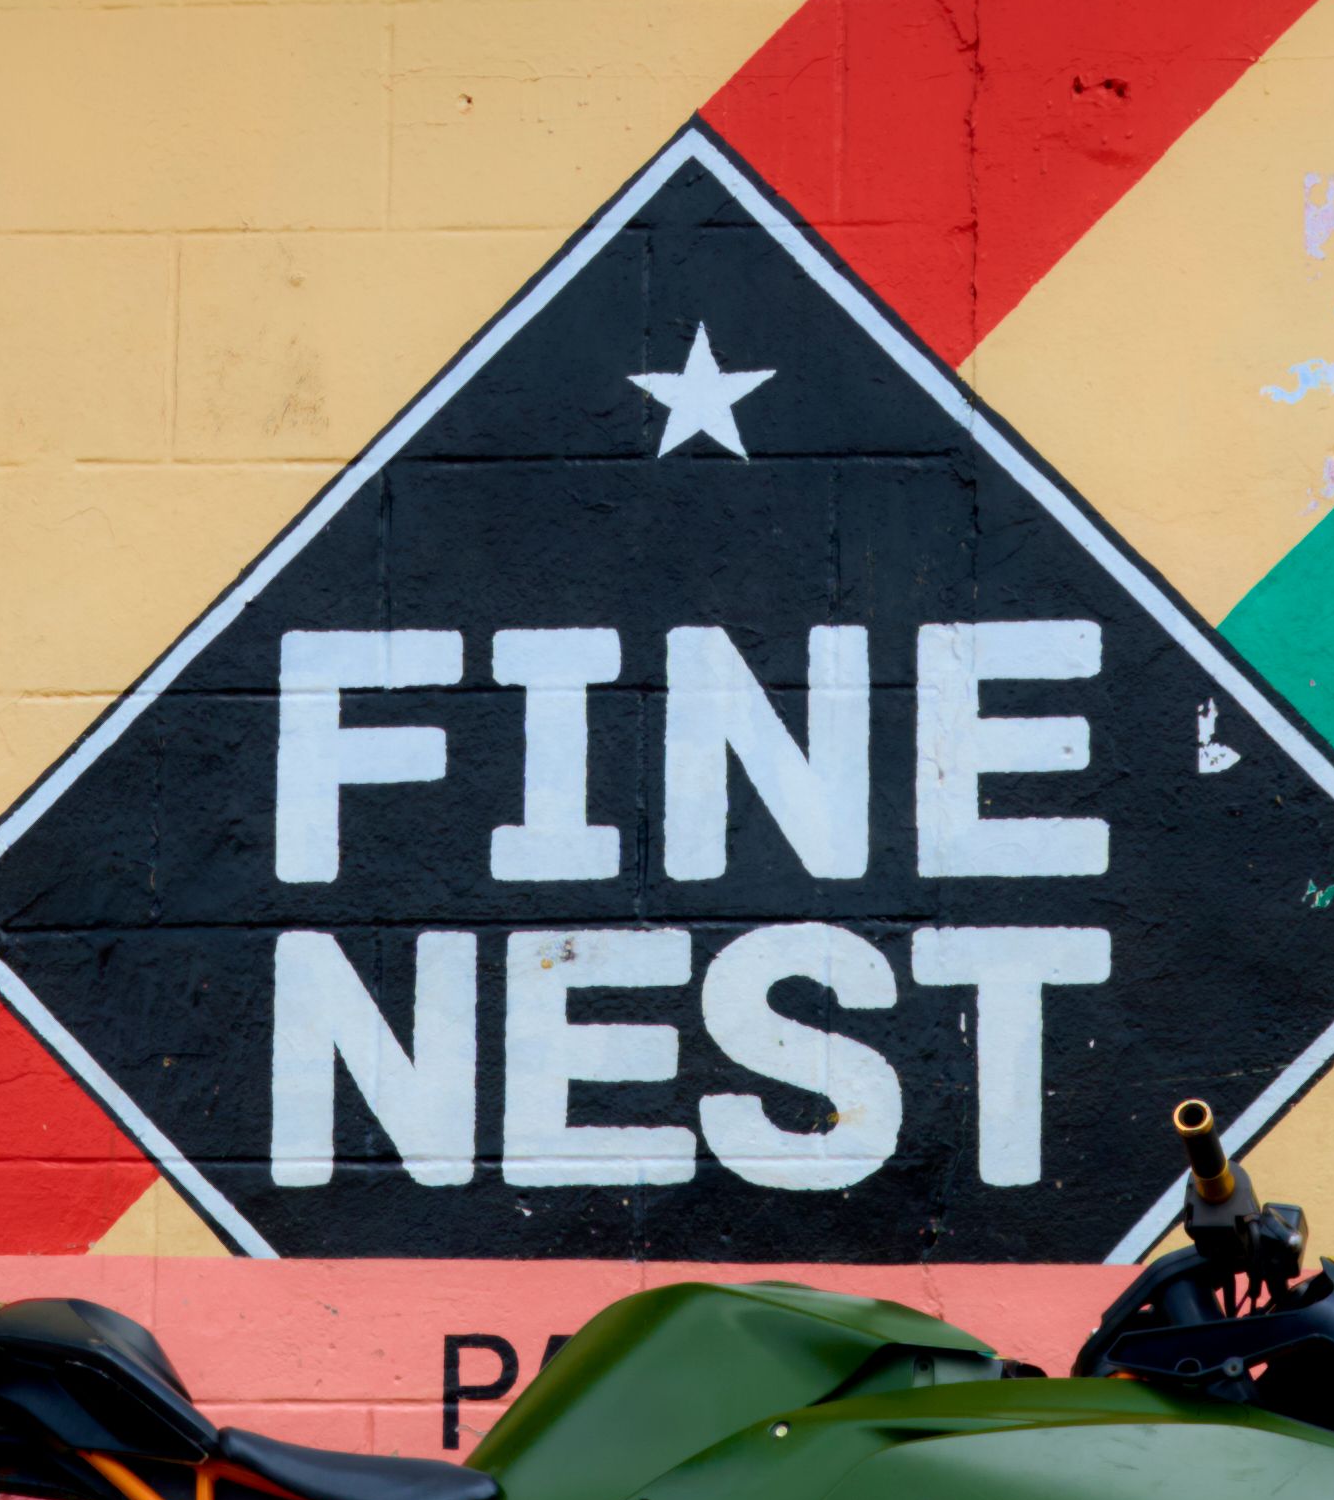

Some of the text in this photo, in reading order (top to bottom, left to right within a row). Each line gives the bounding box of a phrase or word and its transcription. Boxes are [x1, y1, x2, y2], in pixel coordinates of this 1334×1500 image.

[275, 619, 1110, 884] FINE
[270, 921, 1112, 1191] NEST
[442, 1333, 573, 1450] P
